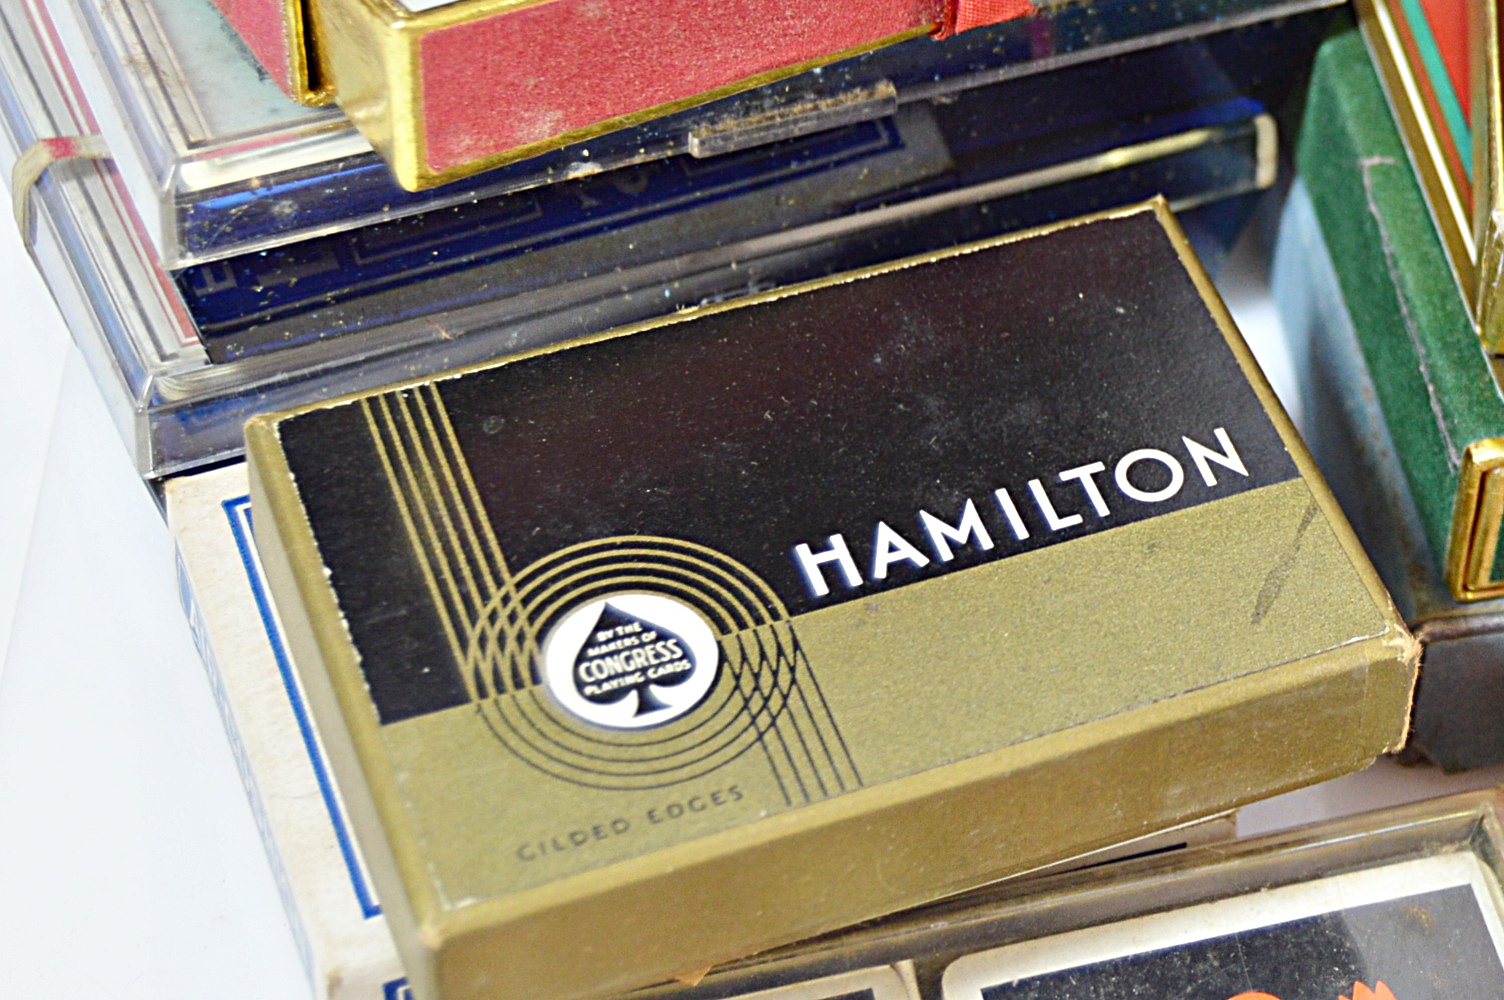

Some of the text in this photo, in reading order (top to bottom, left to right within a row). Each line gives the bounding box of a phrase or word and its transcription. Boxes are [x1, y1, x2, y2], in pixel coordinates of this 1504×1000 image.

[795, 427, 1249, 597] HAMILTON
[587, 631, 658, 657] MAKERS OF
[596, 621, 643, 642] BY THE
[579, 638, 684, 683] CONGRESS
[583, 659, 693, 697] PLAYING CARDS
[515, 784, 745, 863] GILDED EDGES
